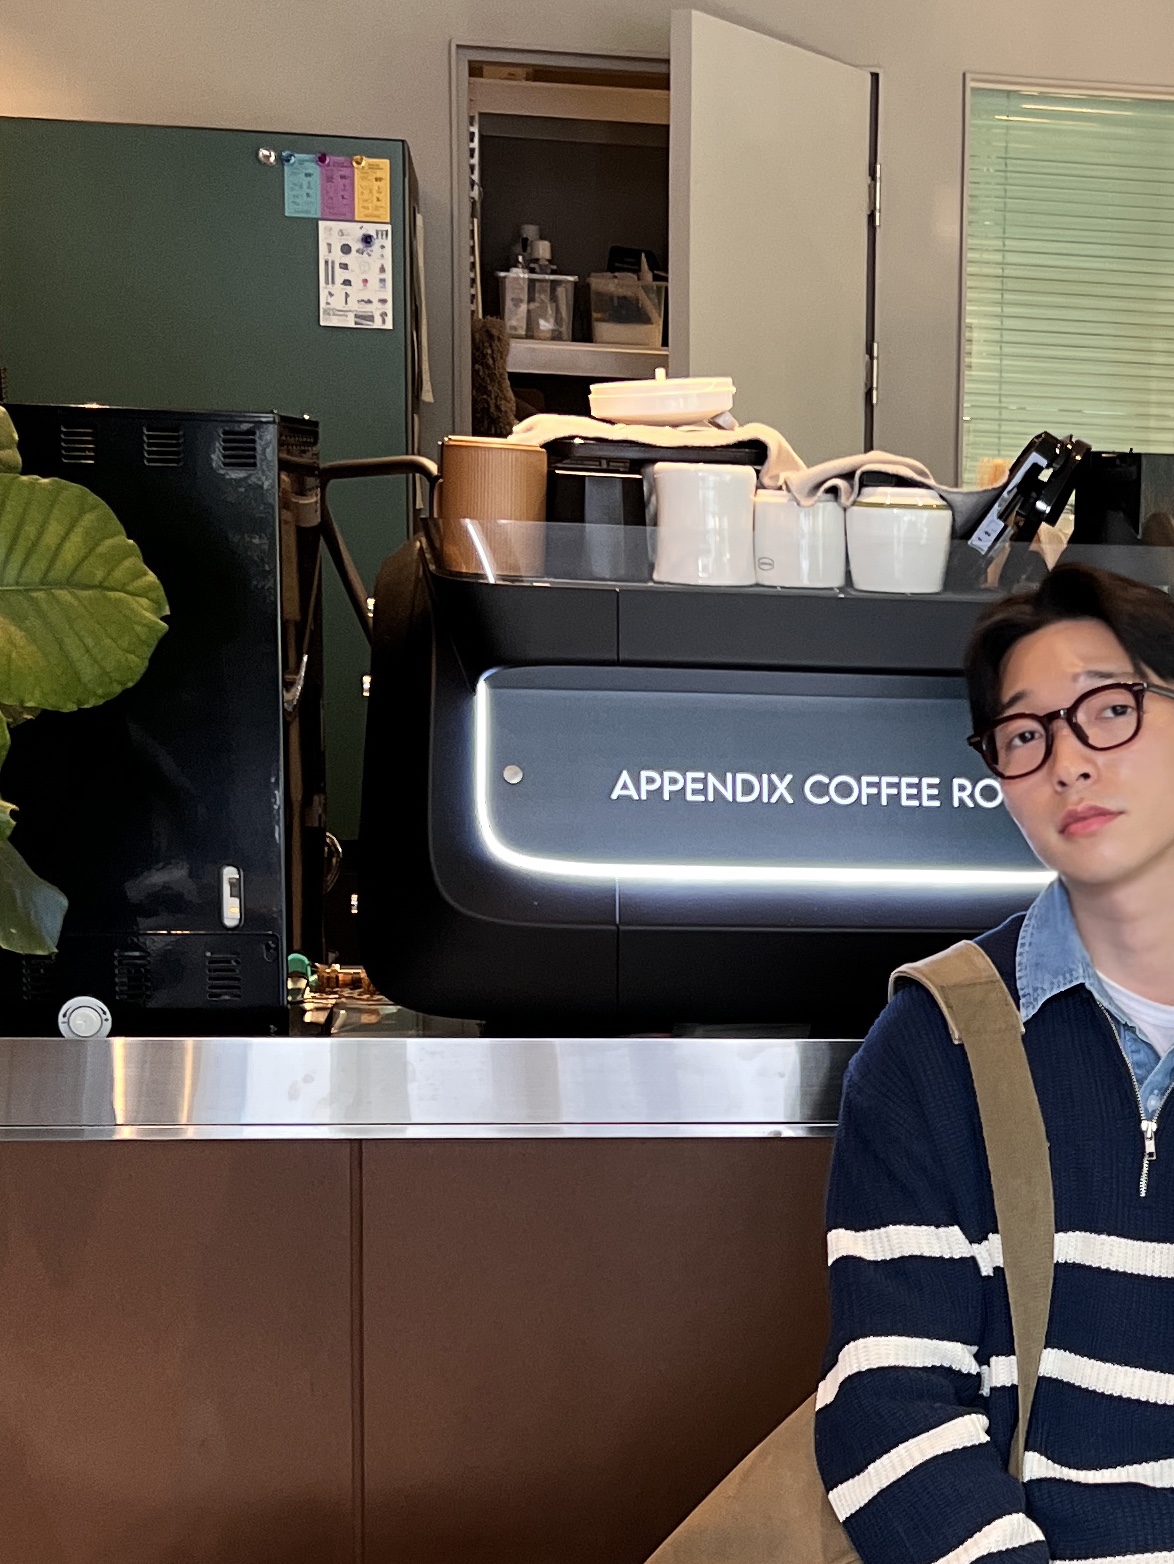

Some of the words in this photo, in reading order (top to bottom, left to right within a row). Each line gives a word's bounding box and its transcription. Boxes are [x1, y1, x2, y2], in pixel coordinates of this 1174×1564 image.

[610, 769, 794, 804] APPENDIX
[803, 774, 941, 808] COFFEE
[952, 777, 1004, 809] RO
